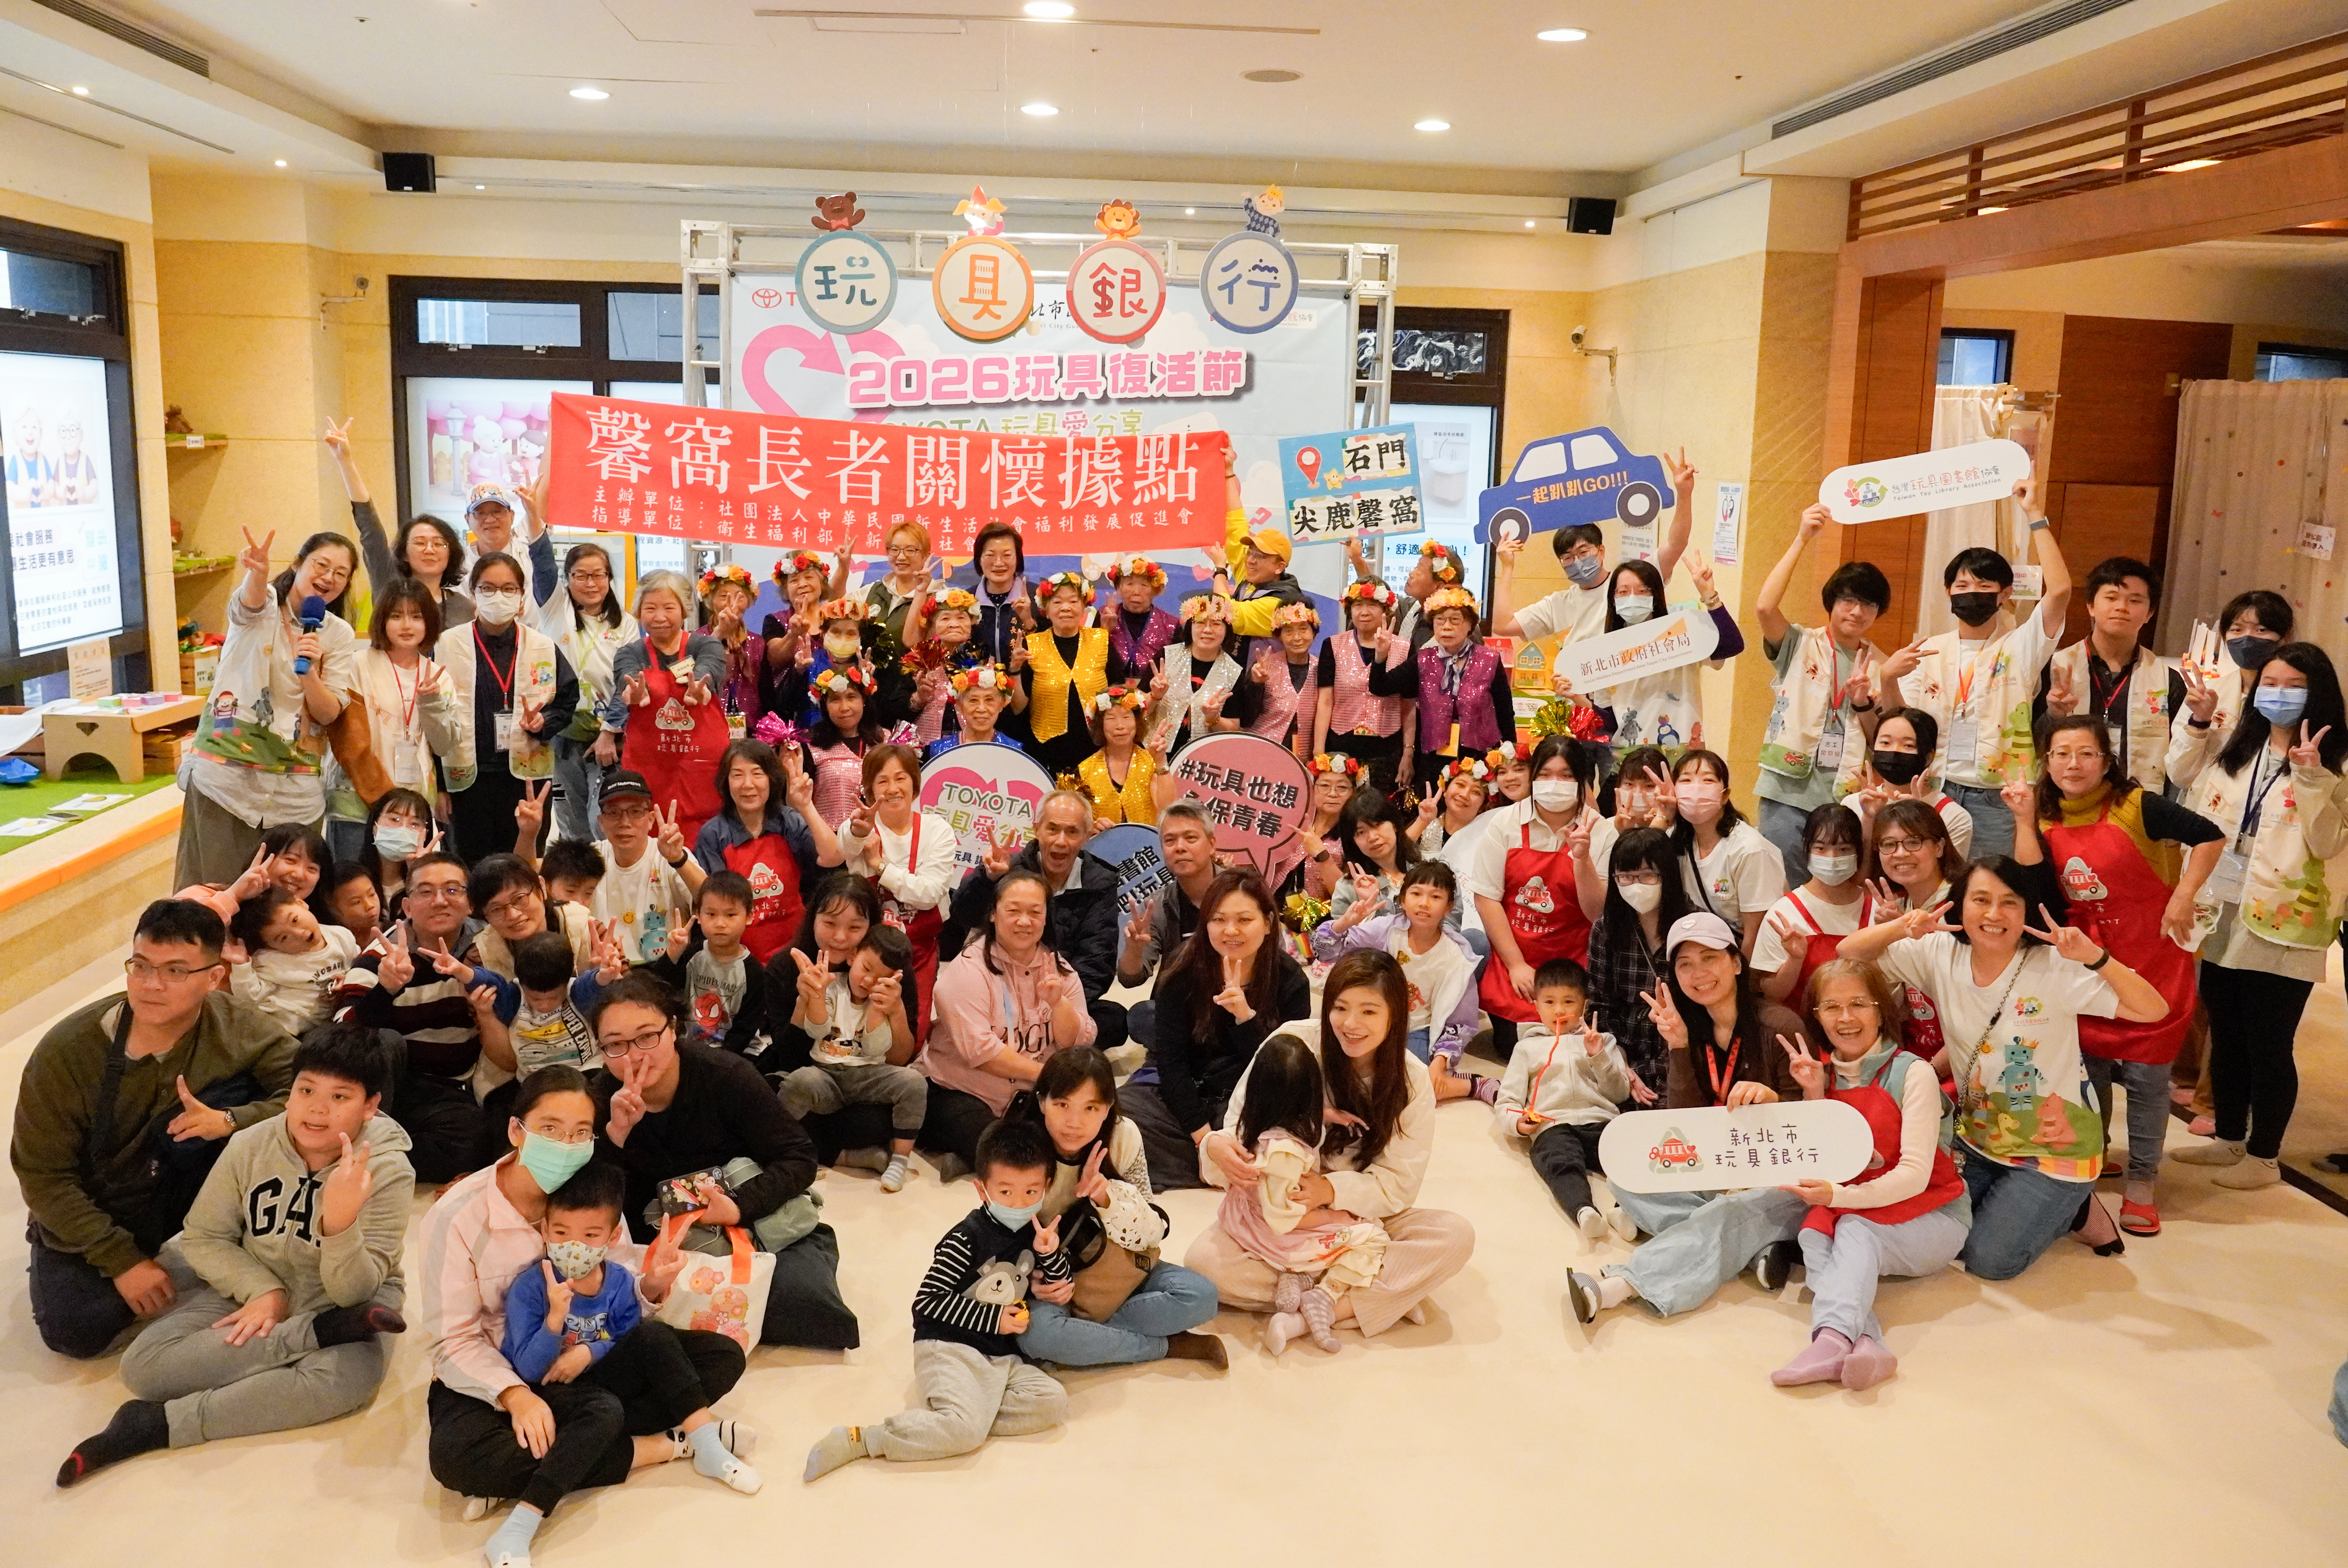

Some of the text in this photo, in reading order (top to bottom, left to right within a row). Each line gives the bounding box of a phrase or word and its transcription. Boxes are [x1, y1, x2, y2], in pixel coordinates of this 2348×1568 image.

[813, 254, 1281, 321] 玩 具 銀 行
[850, 351, 1244, 404] 2026玩具復活節
[586, 406, 1199, 509] 馨窩長者關懷據點
[1344, 438, 1406, 474] 石門
[1892, 465, 2000, 494] 台灣玩具圖書館協會
[1935, 486, 1960, 494] Library
[1964, 478, 2001, 489] Association
[594, 485, 1194, 534] 主辦單位：社團法人中華民國新生活會福利發展促進會
[1293, 494, 1418, 535] 尖鹿馨窩
[1581, 632, 1691, 676] 新北市政府社會局
[1584, 676, 1597, 684] Social
[1596, 673, 1612, 683] Welfare
[1646, 659, 1659, 668] Taipei
[1659, 657, 1668, 665] City
[1667, 650, 1693, 662] Government
[657, 744, 699, 753] 玩具銀行
[660, 733, 691, 743] 新北市
[945, 783, 1032, 818] TOYOTA
[1178, 758, 1299, 809] #玩具也想
[1182, 790, 1283, 838] 保青春
[1117, 845, 1161, 887] 書館
[1512, 919, 1555, 933] 玩具銀行
[1516, 908, 1548, 925] 新北市
[1730, 1123, 1799, 1146] 新北市
[1714, 1147, 1819, 1168] 玩具銀行
[249, 1174, 322, 1248] GA
